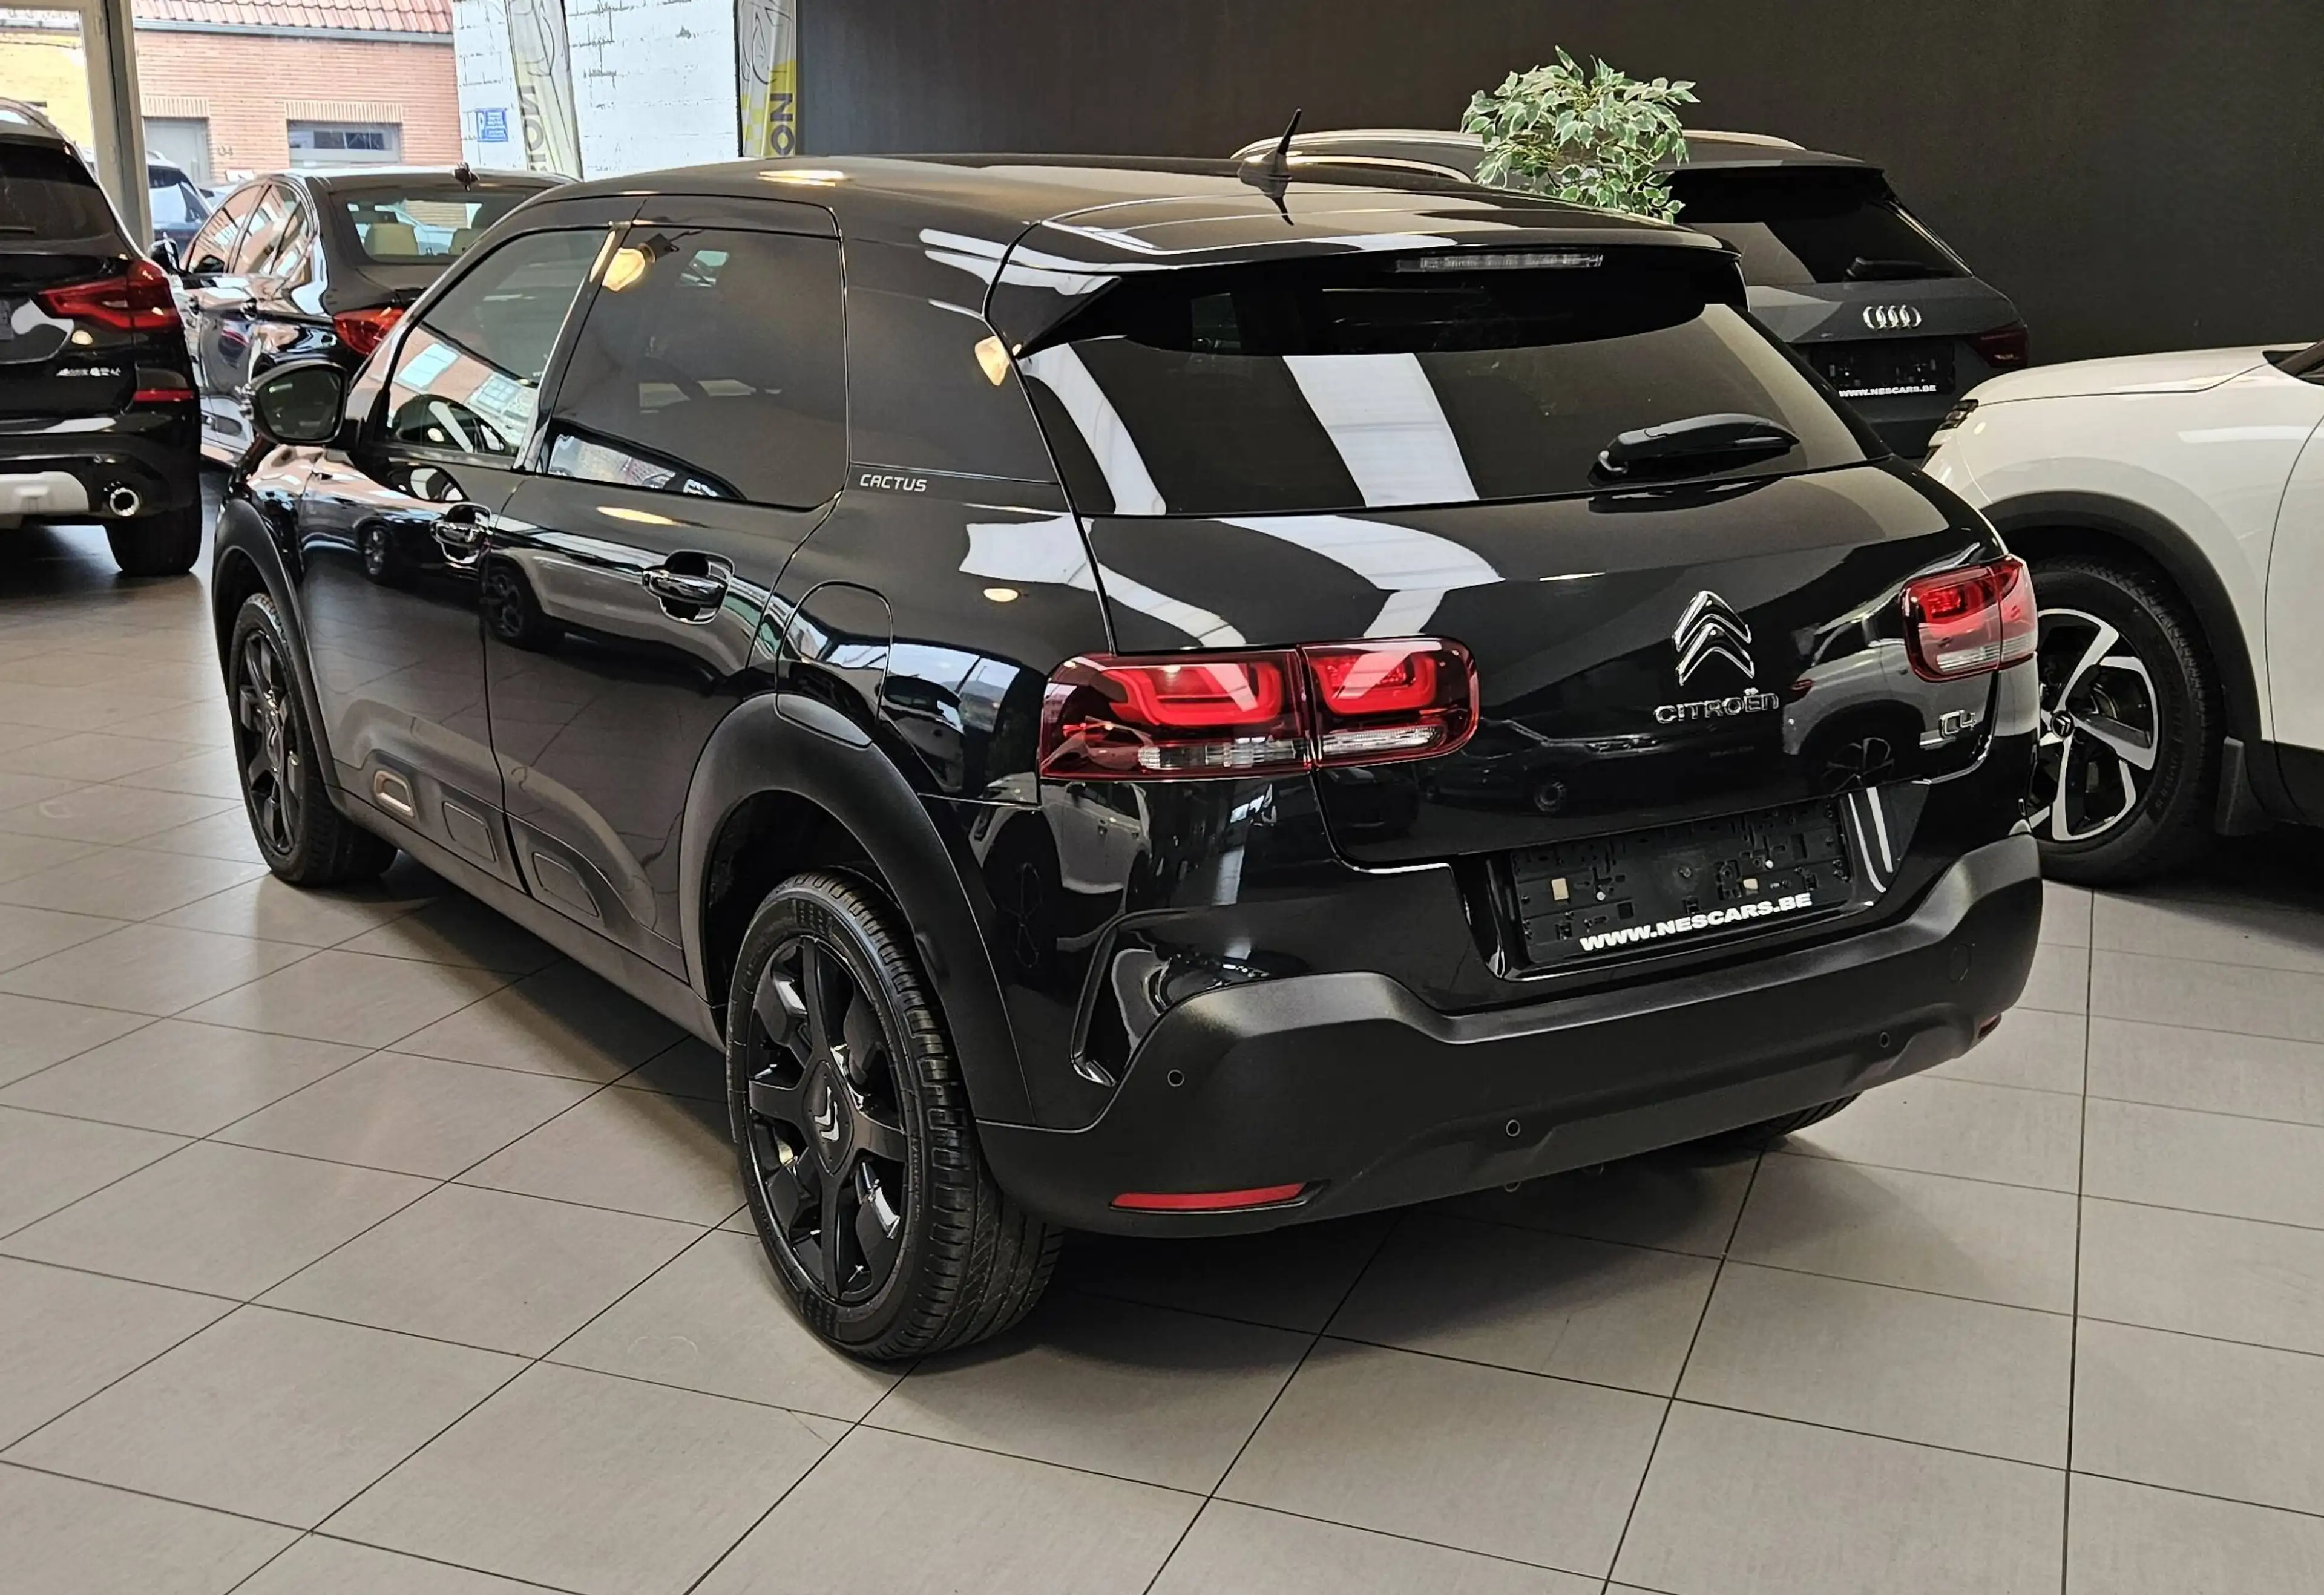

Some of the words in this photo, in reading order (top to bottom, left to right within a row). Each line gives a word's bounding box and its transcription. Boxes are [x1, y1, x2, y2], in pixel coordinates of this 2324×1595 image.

[1838, 385, 1937, 398] WWW.NESCARS.BE
[859, 474, 927, 492] CACTUS
[1938, 709, 1977, 736] C4
[1579, 892, 1813, 952] WWW.NESCARS.BE
